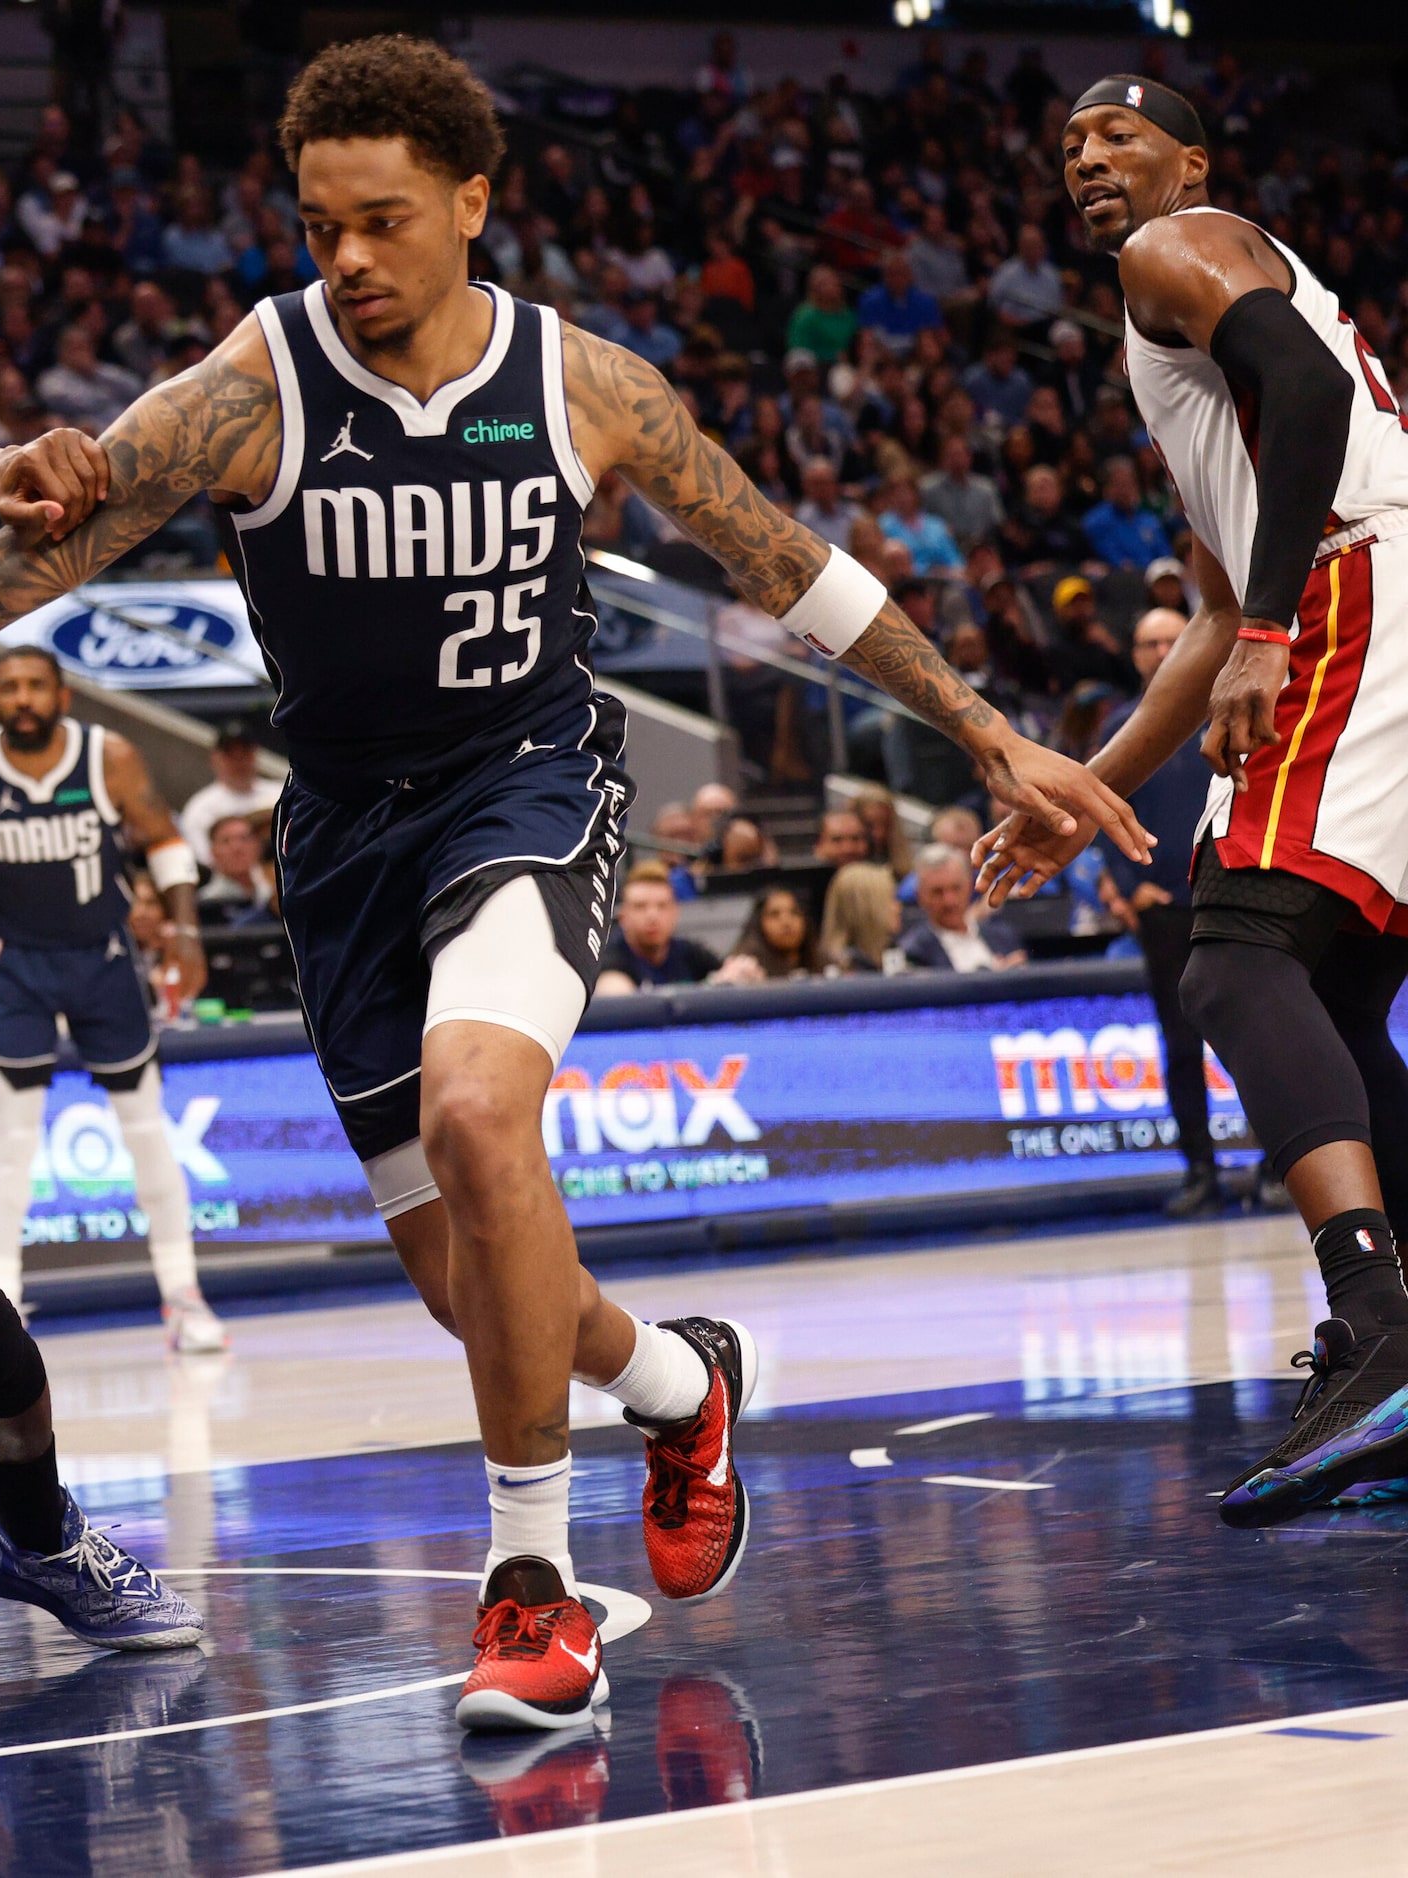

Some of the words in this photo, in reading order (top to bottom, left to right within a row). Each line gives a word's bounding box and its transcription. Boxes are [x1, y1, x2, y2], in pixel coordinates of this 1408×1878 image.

[463, 418, 535, 444] chime
[78, 604, 211, 668] Ford
[438, 574, 547, 689] 25
[70, 852, 103, 906] 11
[1007, 1125, 1060, 1160] THE
[1059, 1123, 1118, 1156] ONE
[1117, 1118, 1157, 1150] TO
[625, 1159, 669, 1194] TO
[80, 1207, 128, 1239] TO
